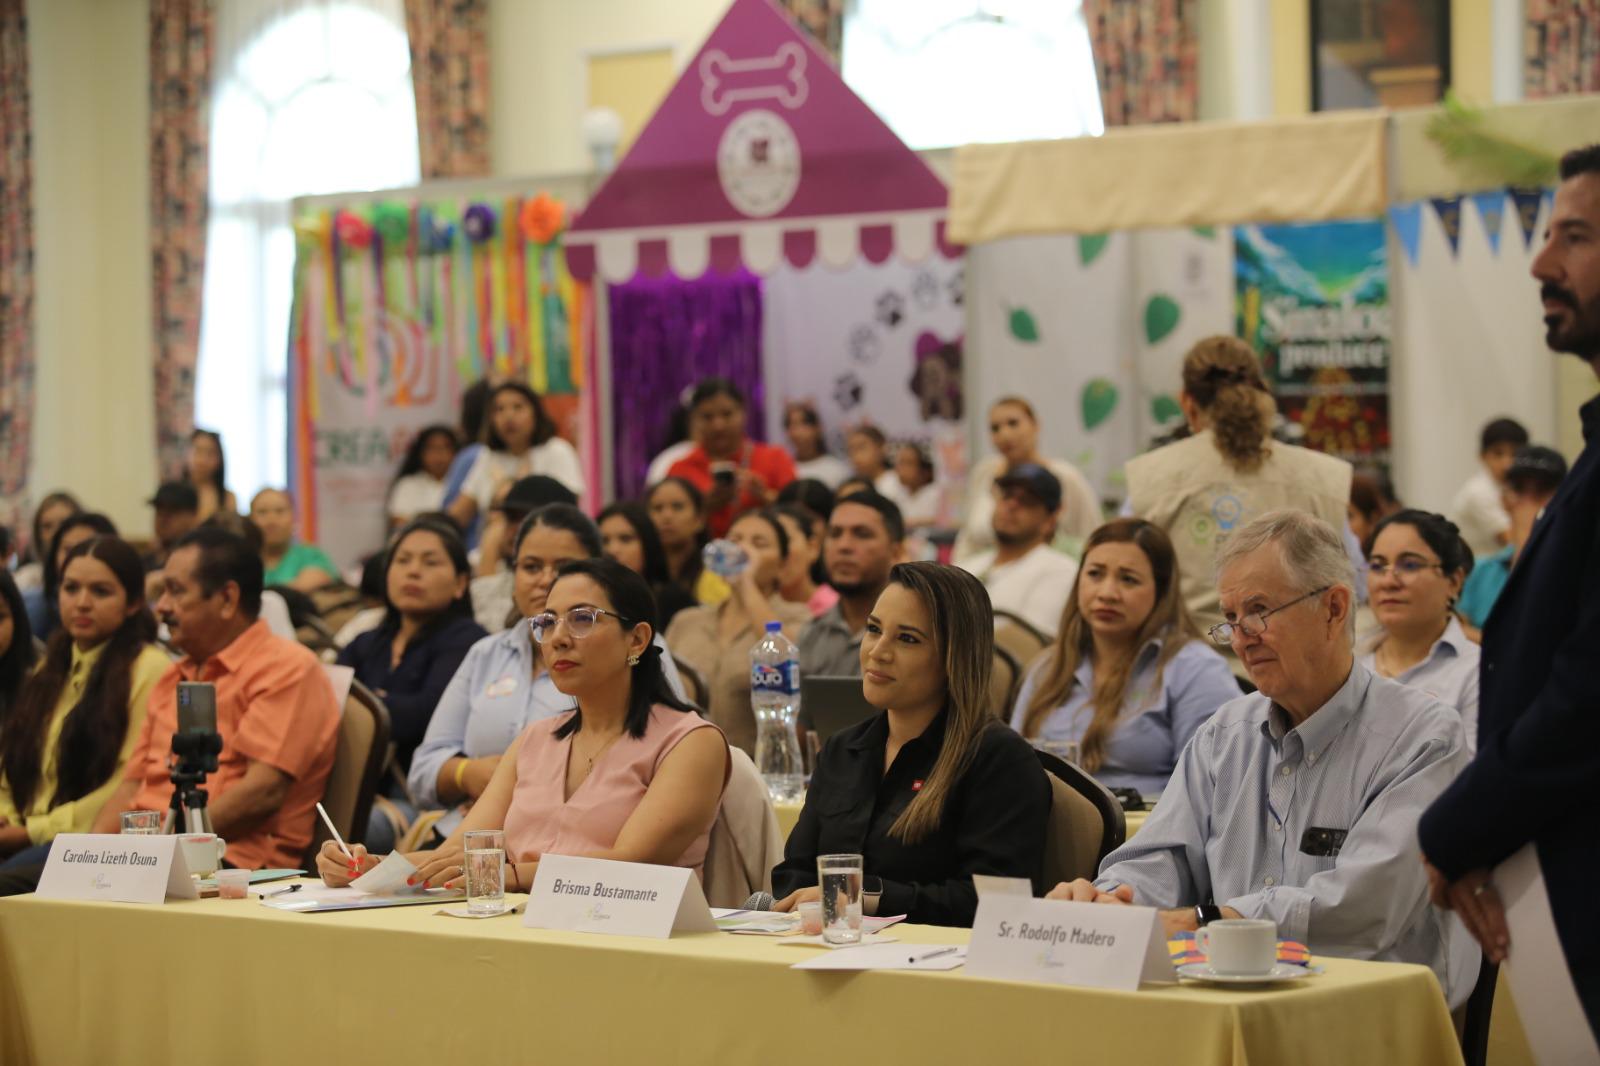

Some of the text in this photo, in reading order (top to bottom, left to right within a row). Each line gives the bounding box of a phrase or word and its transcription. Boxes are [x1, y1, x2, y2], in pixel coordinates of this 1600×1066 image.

[63, 849, 158, 866] Carolina Lizeth Osuna
[552, 878, 658, 902] Brisma Bustamante
[998, 920, 1116, 947] Sr. Rodolfo Madero
